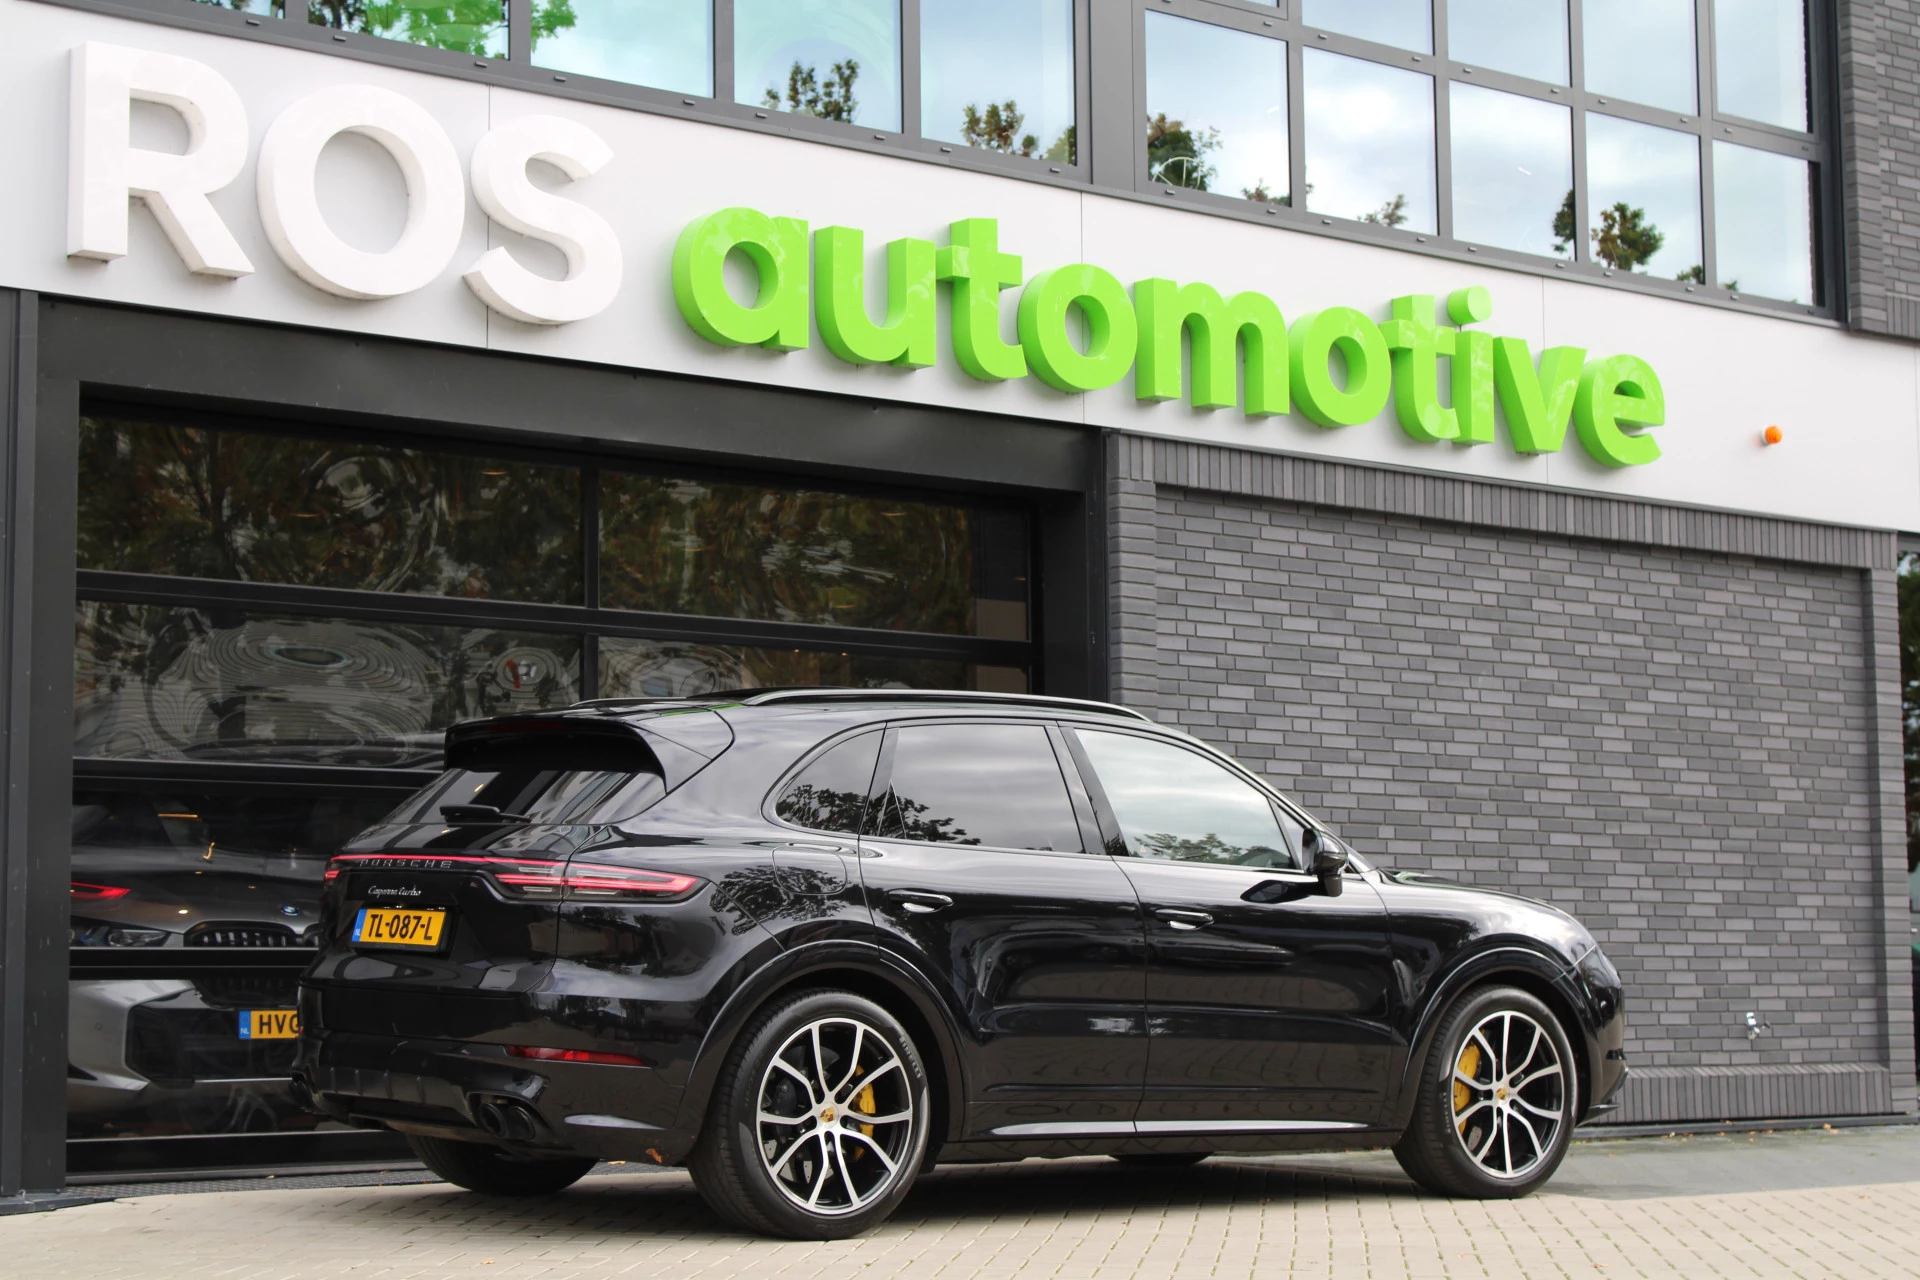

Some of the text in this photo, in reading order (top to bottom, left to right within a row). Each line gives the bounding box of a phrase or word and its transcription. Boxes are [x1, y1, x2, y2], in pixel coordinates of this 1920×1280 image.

[67, 40, 1666, 470] ROS automotive
[360, 858, 452, 869] PORSCHE
[368, 914, 433, 941] TL-087-L
